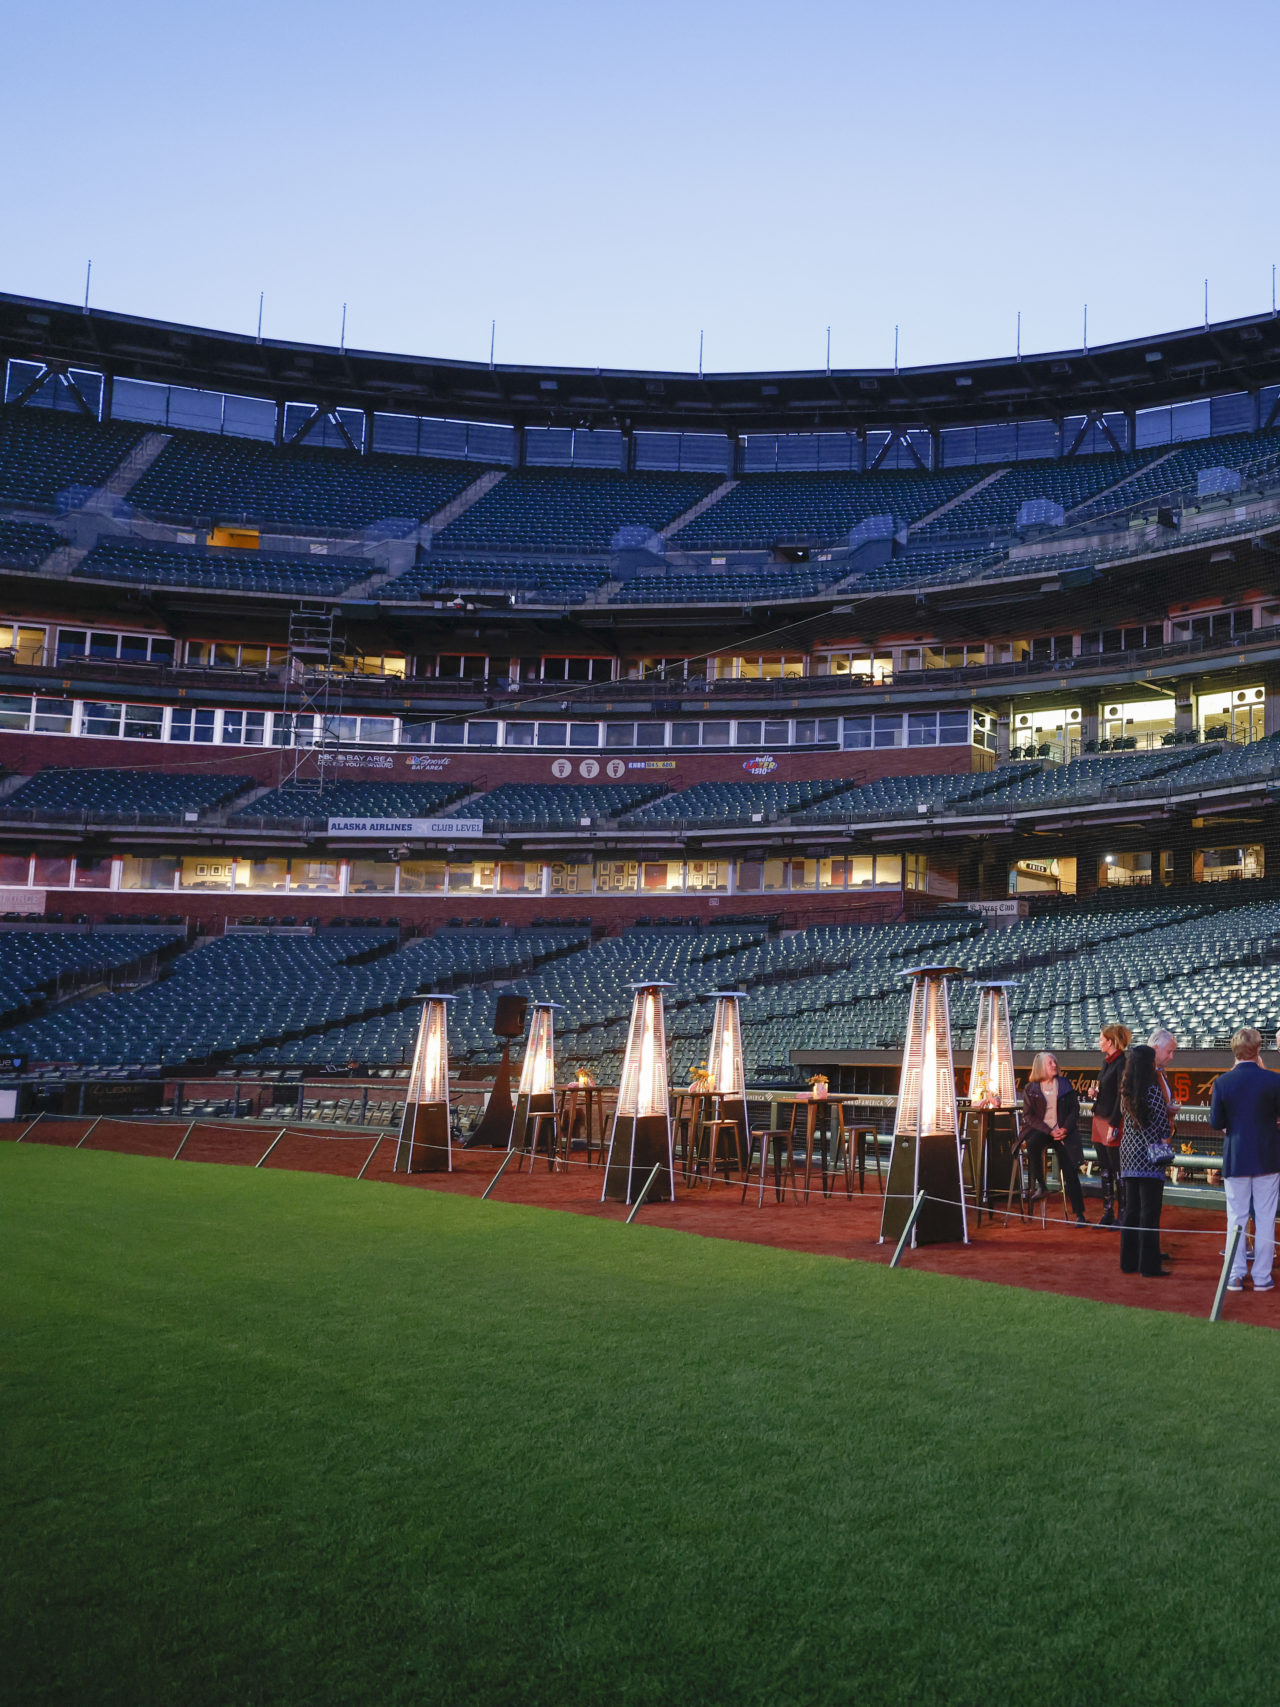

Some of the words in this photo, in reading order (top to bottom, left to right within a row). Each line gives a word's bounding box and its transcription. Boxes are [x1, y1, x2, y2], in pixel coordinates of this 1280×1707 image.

[318, 753, 333, 761] NBC
[419, 755, 451, 766] Sports
[746, 761, 776, 769] LAZER
[330, 822, 367, 831] ALASKA
[369, 823, 412, 831] AIRLINES
[431, 823, 452, 832] CLUB
[455, 824, 482, 832] LEVEL
[999, 904, 1015, 912] Club
[1174, 1113, 1208, 1122] AMERICA
